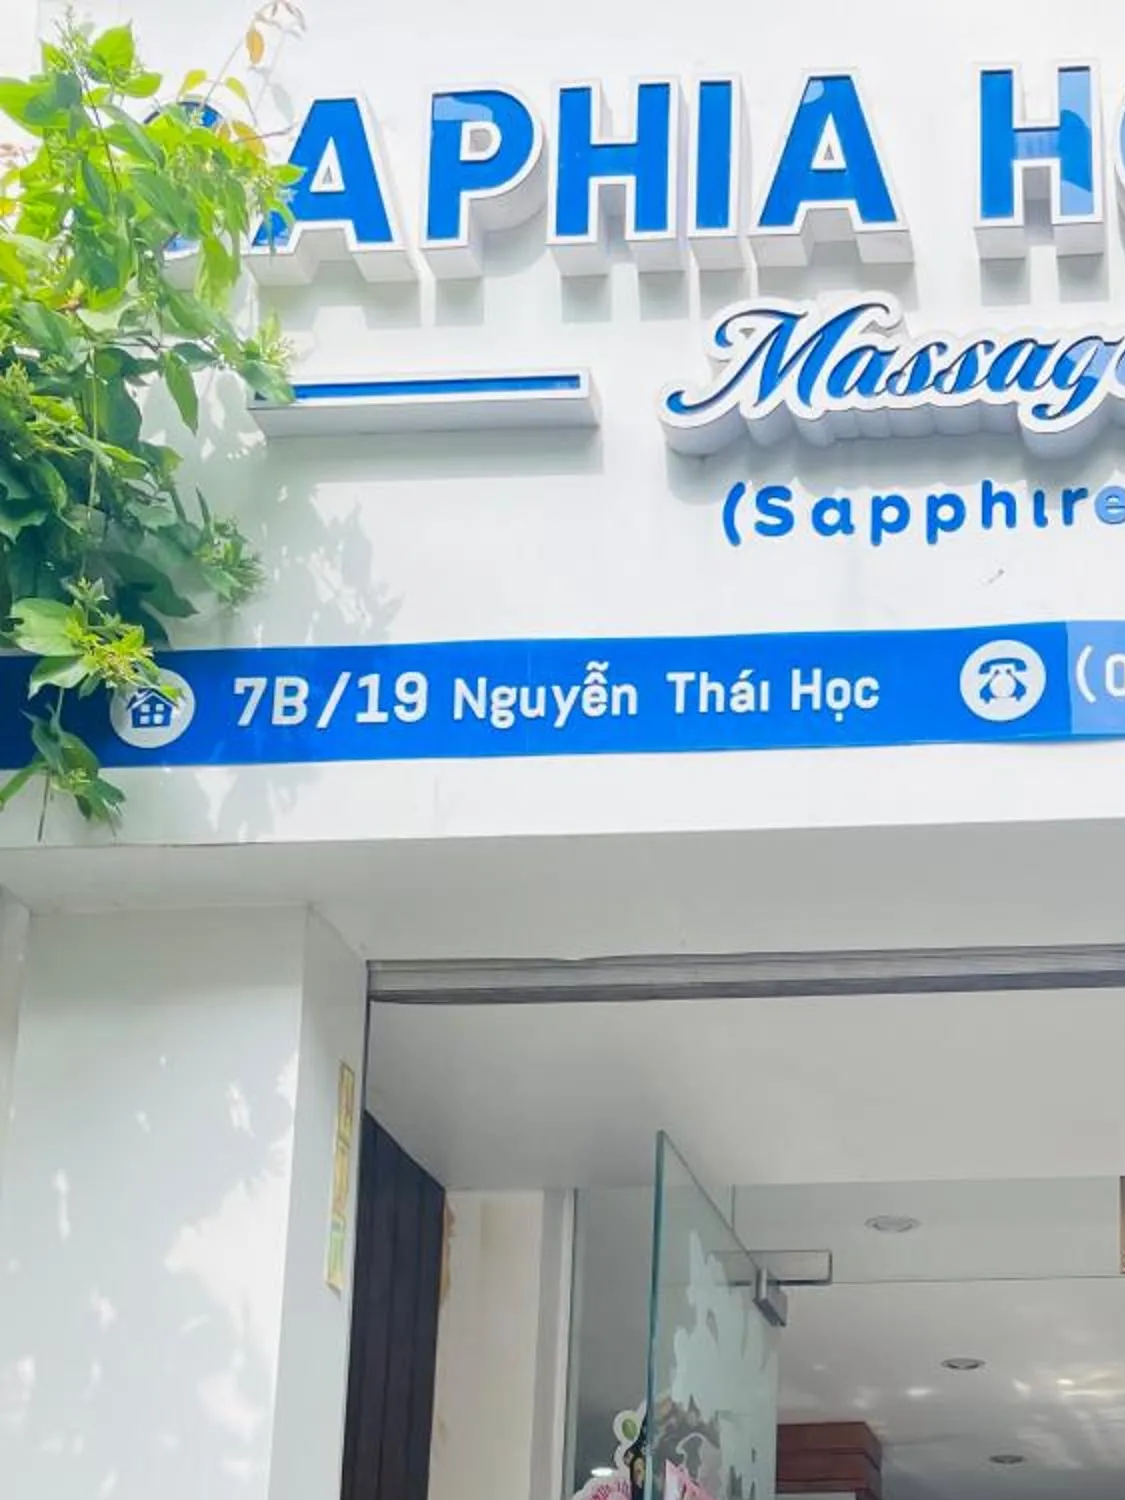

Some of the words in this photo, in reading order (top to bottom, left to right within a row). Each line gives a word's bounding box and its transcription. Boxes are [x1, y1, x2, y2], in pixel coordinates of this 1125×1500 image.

[148, 74, 900, 258] APHIA
[235, 672, 427, 728] 7B/19
[454, 661, 638, 729] Nguyễn
[790, 667, 879, 722] Học
